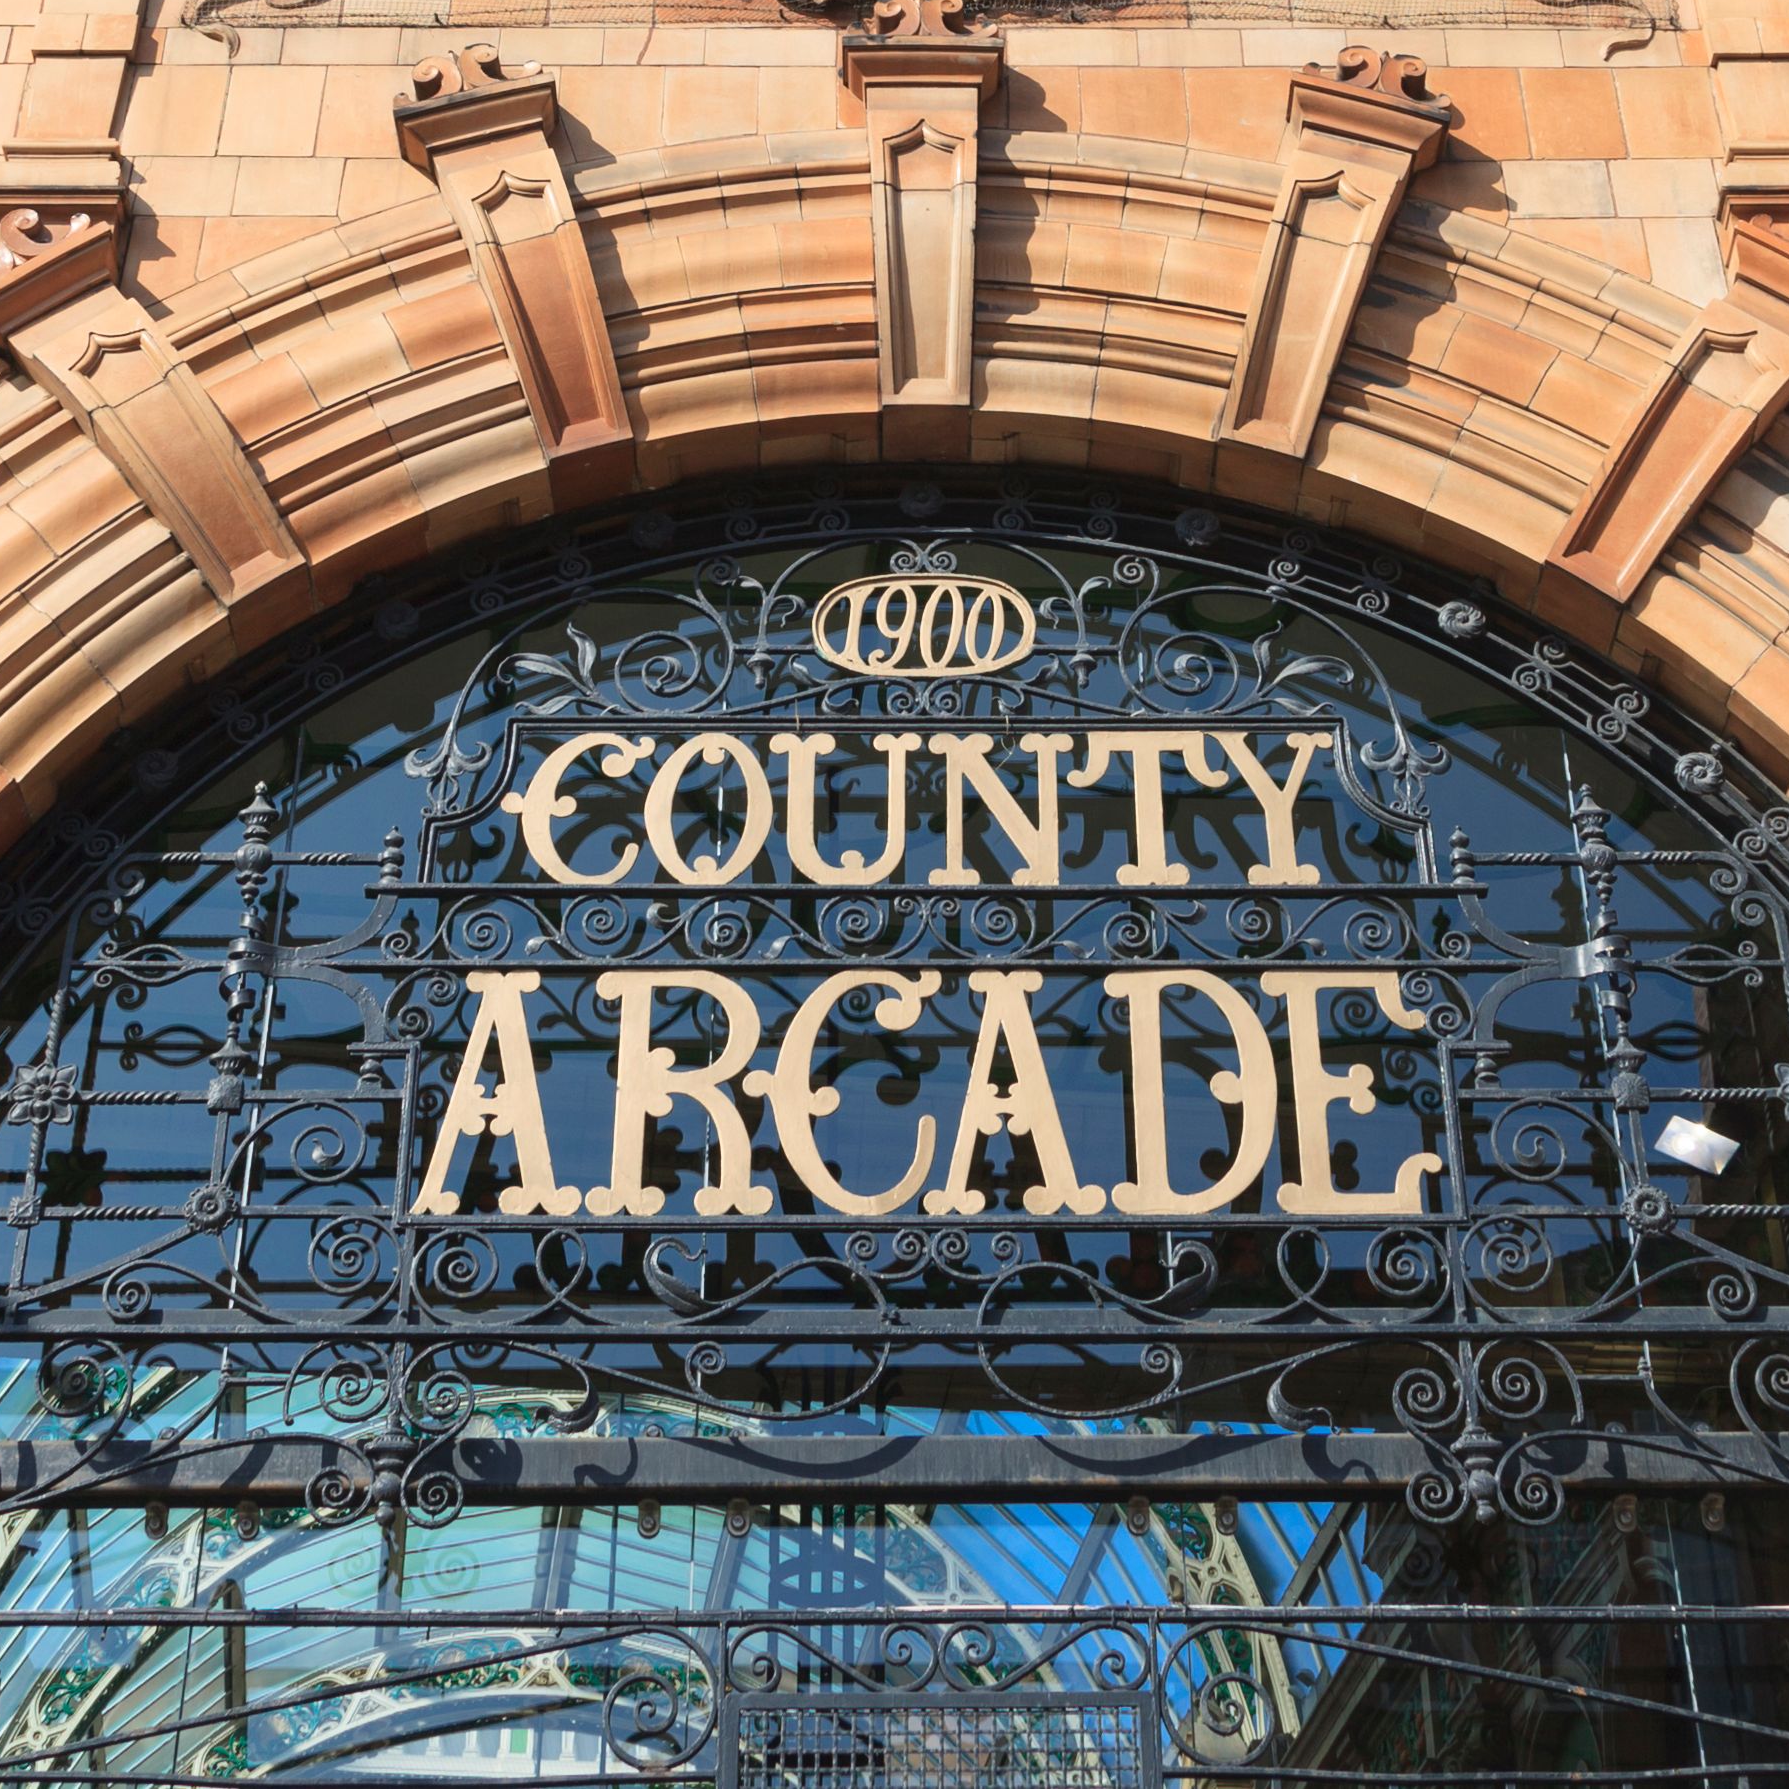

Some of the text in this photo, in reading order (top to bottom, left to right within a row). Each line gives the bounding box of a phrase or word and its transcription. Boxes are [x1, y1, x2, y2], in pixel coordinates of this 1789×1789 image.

[836, 583, 1006, 670] 1900
[500, 731, 1333, 887] COUNTY
[412, 970, 1443, 1217] ARCADE
